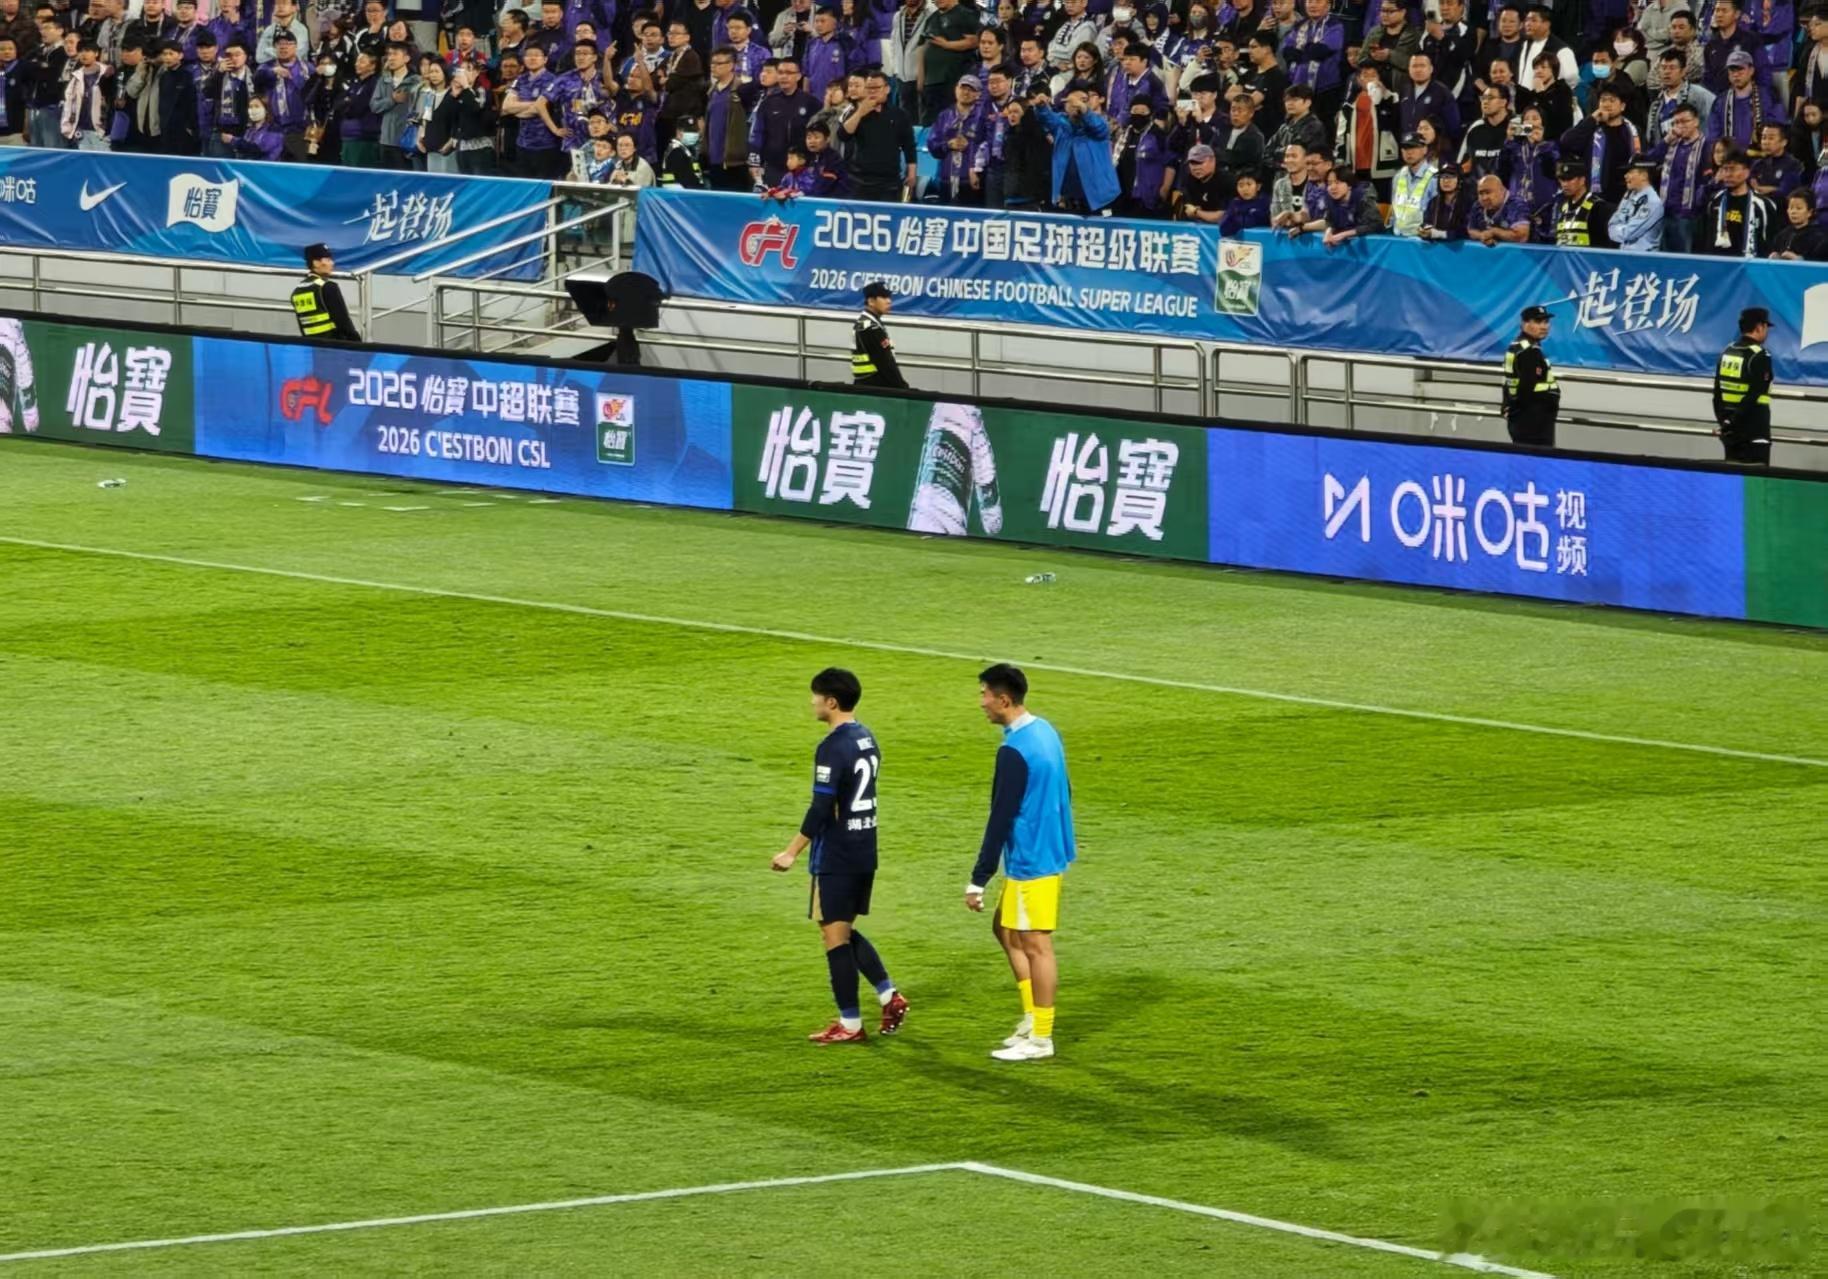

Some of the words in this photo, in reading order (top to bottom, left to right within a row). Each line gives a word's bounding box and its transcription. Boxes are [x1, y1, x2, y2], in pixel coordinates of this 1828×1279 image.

[184, 186, 223, 220] 怡寶
[814, 210, 892, 252] 2026
[896, 216, 949, 257] 怡寶
[952, 218, 1200, 276] 中国足球超级联赛
[810, 268, 848, 291] 2026
[926, 276, 992, 300] CHINESE
[995, 280, 1075, 308] FOOTBALL
[1078, 287, 1132, 313] SUPER
[1134, 293, 1198, 318] LEAGUE
[65, 341, 172, 436] 怡寶
[348, 368, 417, 410] 2026
[420, 374, 469, 416] 怡寶
[472, 379, 580, 427] 中超联赛
[377, 425, 421, 455] 2026
[425, 430, 513, 465] C'ESTBON
[518, 439, 551, 468] CSL
[758, 405, 886, 509] 怡寶
[1040, 432, 1179, 541] 怡寶
[1391, 473, 1549, 572] 咪咕
[1555, 489, 1588, 577] 视频
